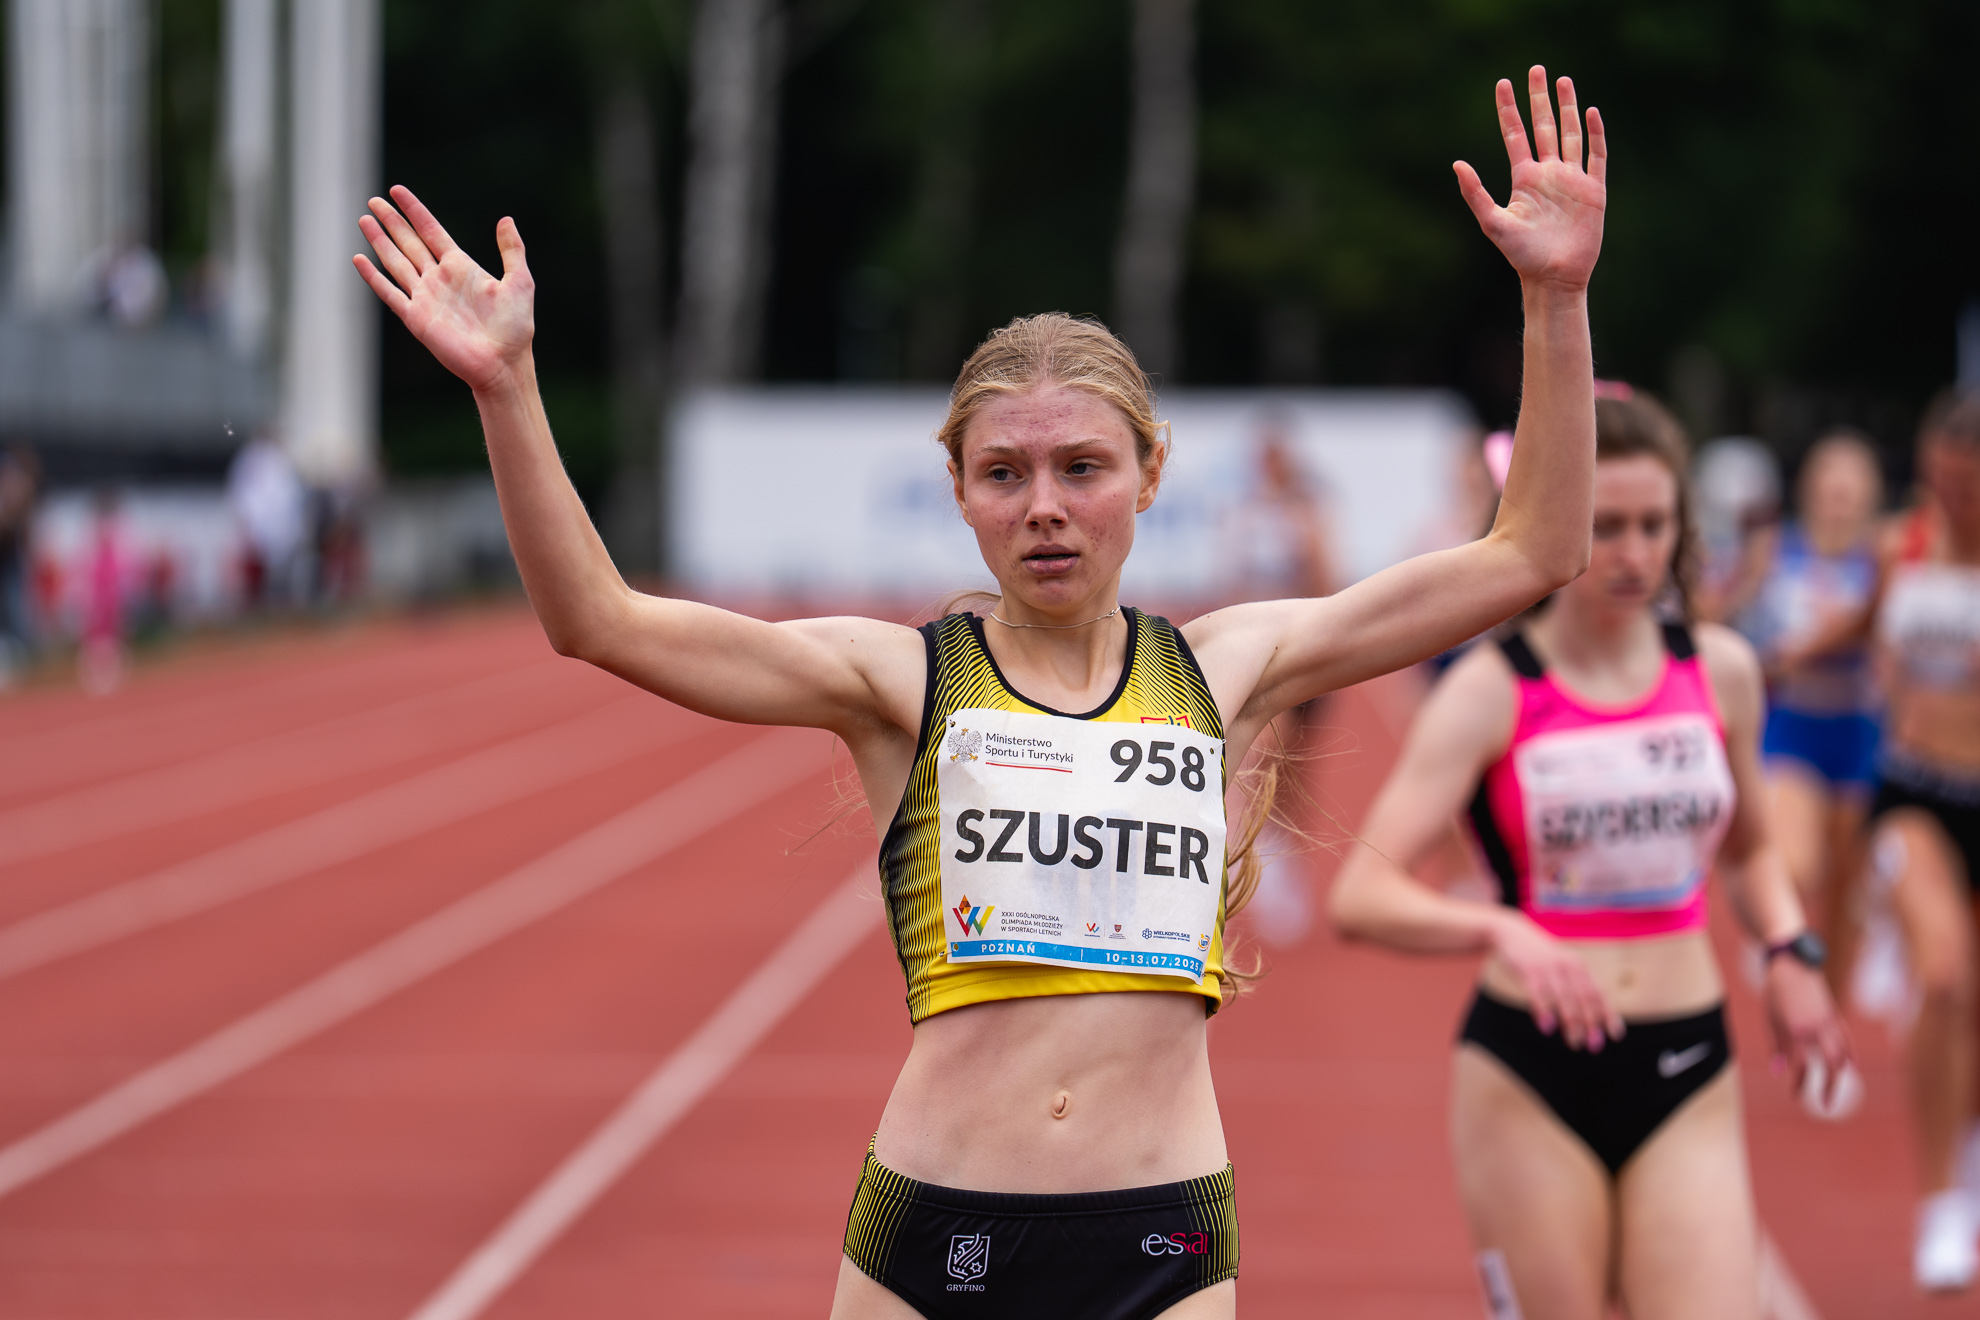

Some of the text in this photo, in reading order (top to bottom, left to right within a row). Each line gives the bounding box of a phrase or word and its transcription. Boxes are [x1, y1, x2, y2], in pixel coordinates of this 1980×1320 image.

[985, 732, 1052, 748] Ministerstwo
[985, 745, 1074, 763] Sportu i Turystyki
[1110, 739, 1206, 793] 958
[954, 808, 1210, 885] SZUSTER
[1001, 918, 1063, 929] OLIMPIADA MŁODZIEŻY
[1015, 911, 1060, 921] OGÓLNOPOLSKA
[1007, 926, 1038, 934] SPORTACH
[1038, 928, 1062, 936] LETNICH
[981, 942, 1036, 954] POZNAŃ
[1105, 952, 1199, 972] 10-13.07.2025
[1141, 1232, 1208, 1256] esa
[946, 1284, 986, 1292] GRYFINO
